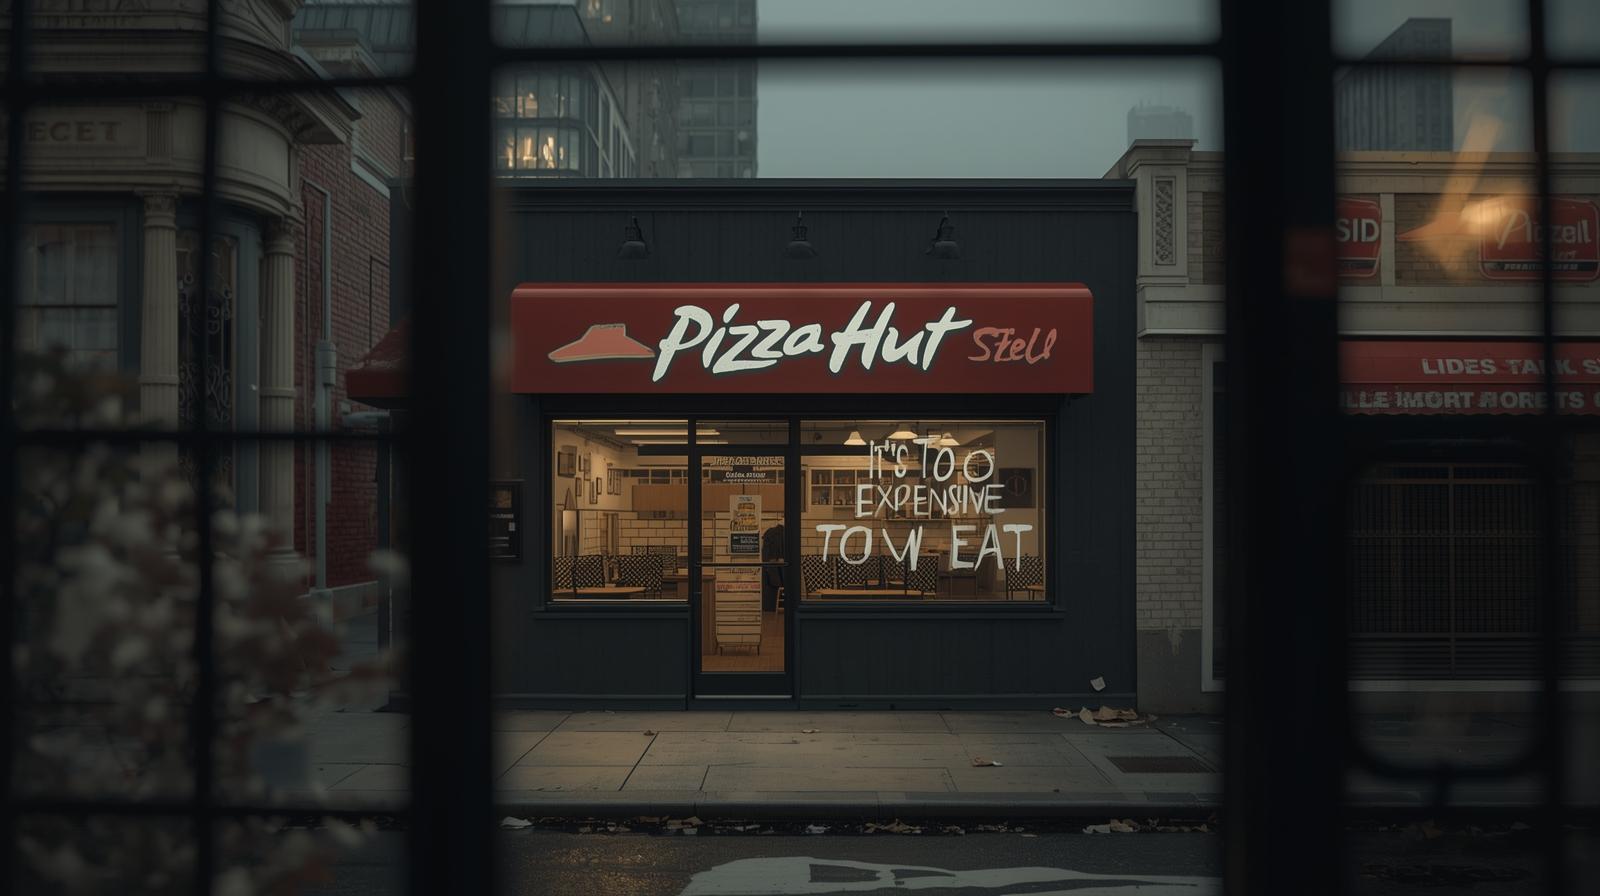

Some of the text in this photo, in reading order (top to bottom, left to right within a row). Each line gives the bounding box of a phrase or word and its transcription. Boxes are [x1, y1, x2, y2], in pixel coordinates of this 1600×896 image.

[651, 302, 824, 382] Pizza
[829, 300, 974, 373] Hut
[1422, 358, 1497, 375] LIDES
[855, 483, 1006, 518] EXPENSIVE
[951, 523, 1033, 572] EAT
